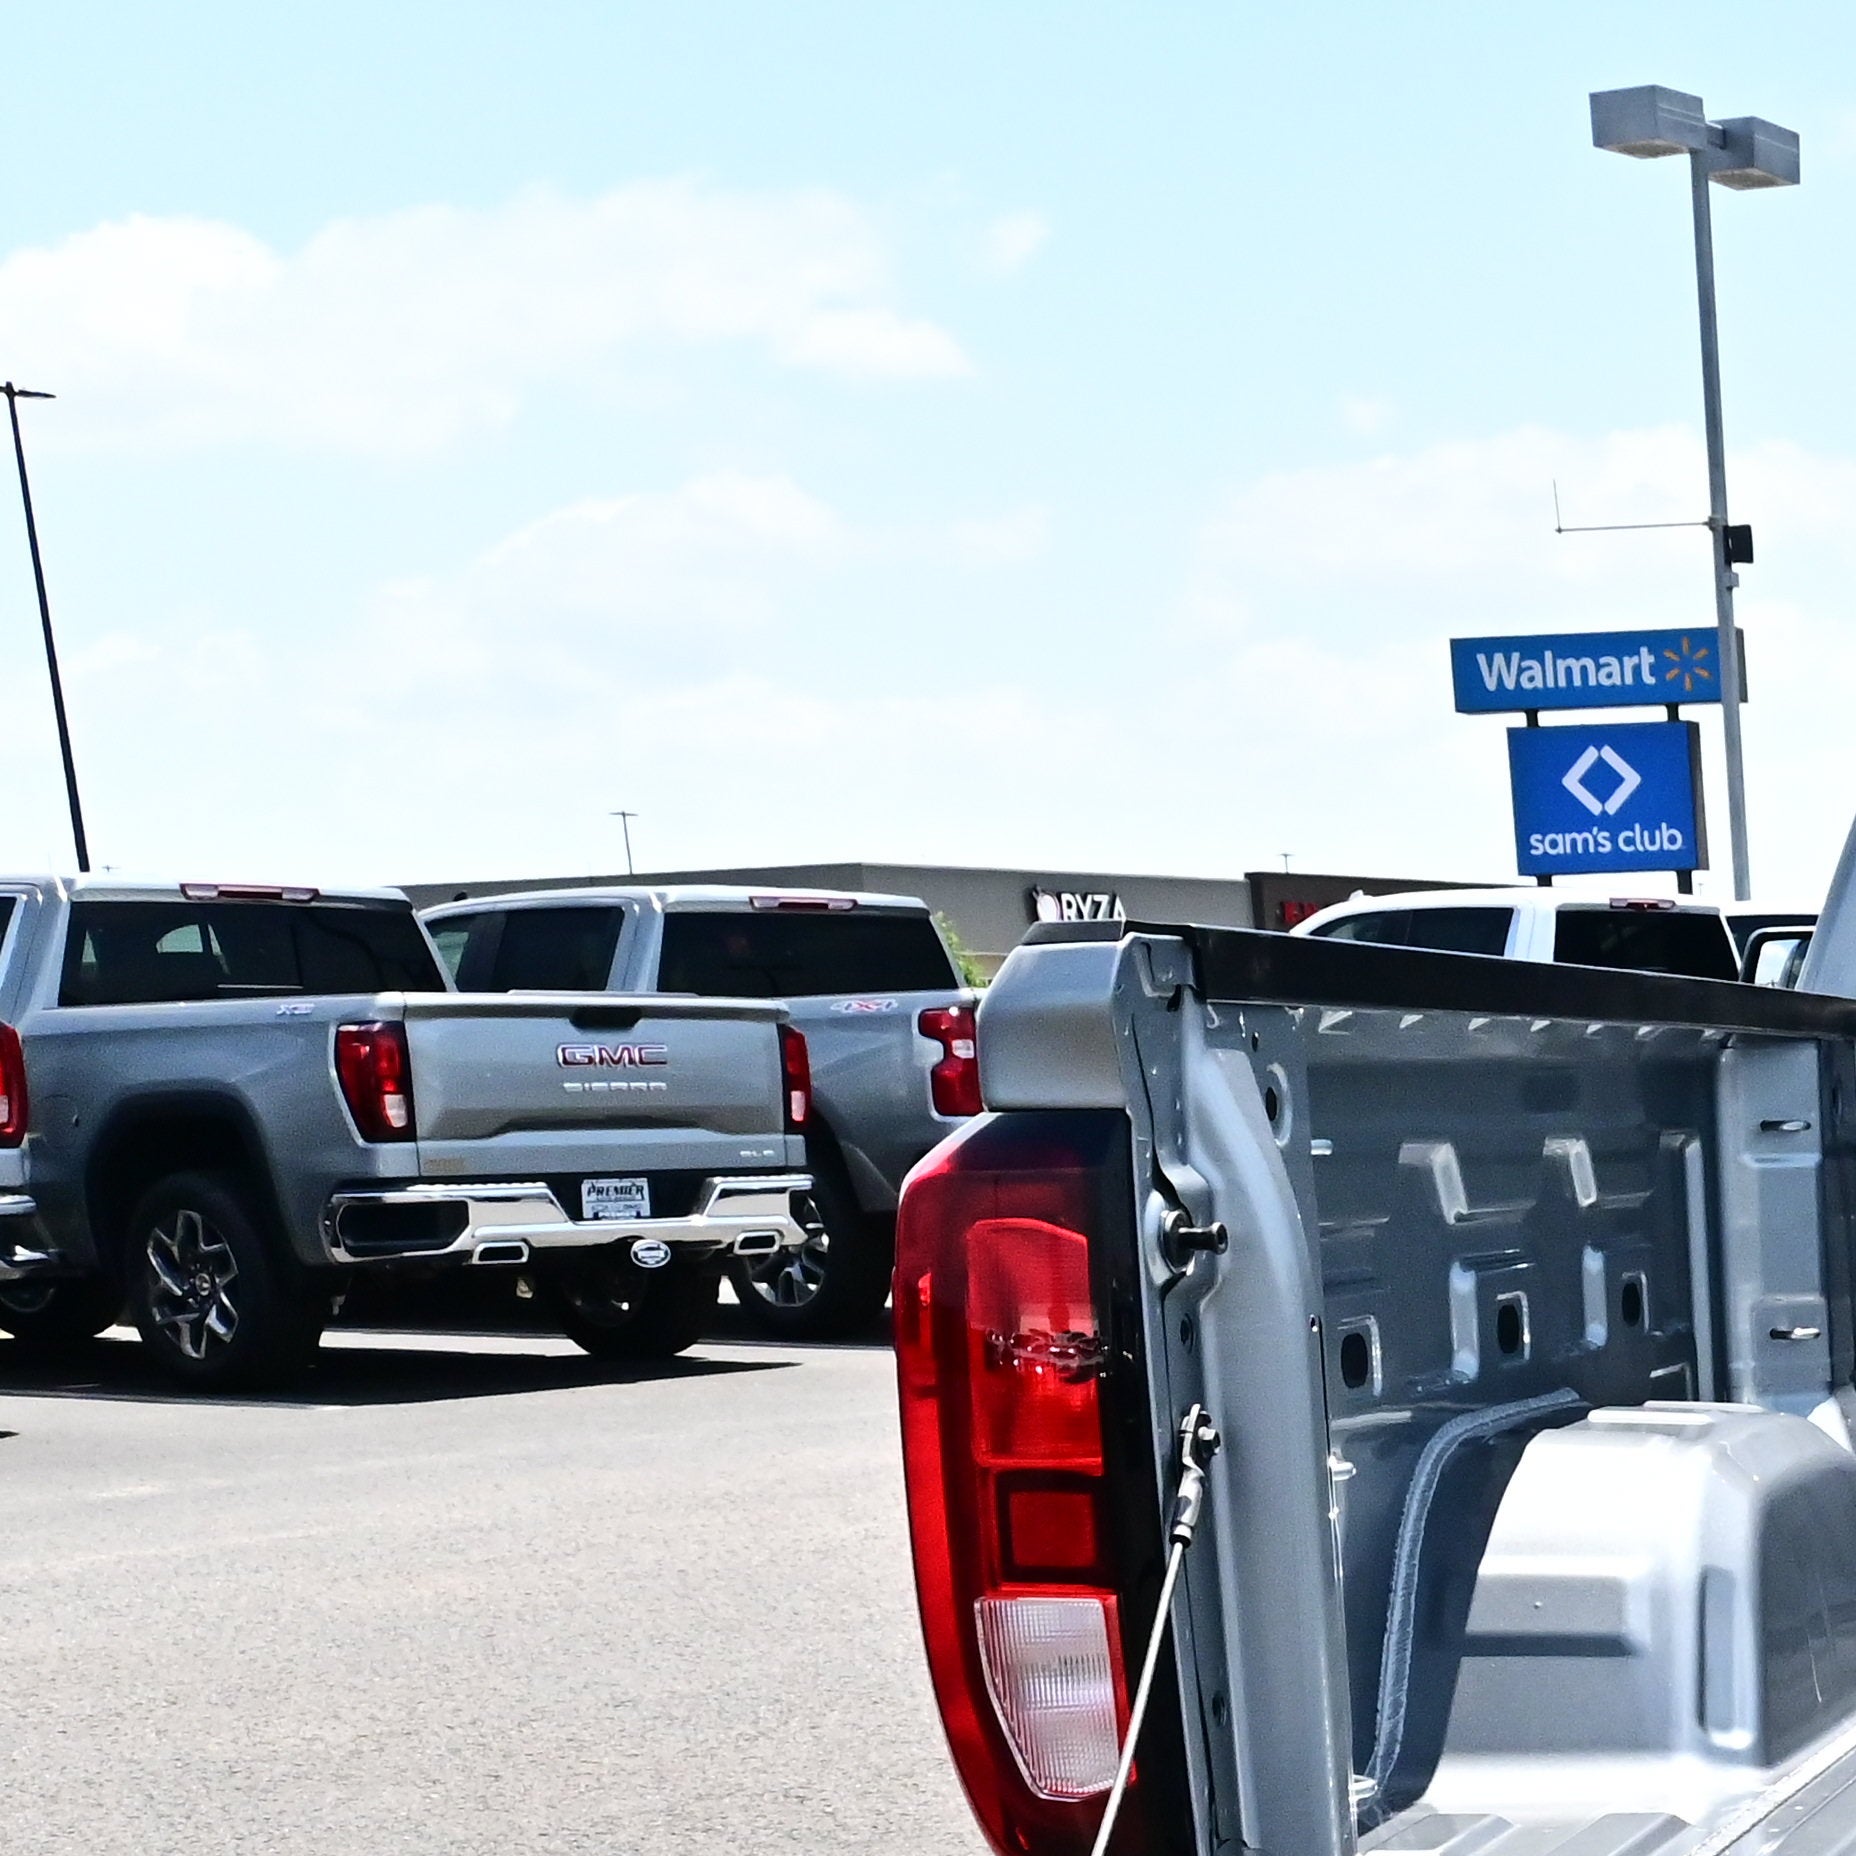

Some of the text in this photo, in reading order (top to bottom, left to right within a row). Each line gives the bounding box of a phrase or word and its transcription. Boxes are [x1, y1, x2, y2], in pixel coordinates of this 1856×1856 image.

[1476, 646, 1656, 691] Walmart
[1529, 821, 1683, 856] sam's club
[558, 1044, 669, 1068] GMC
[587, 1182, 645, 1200] PREMIER
